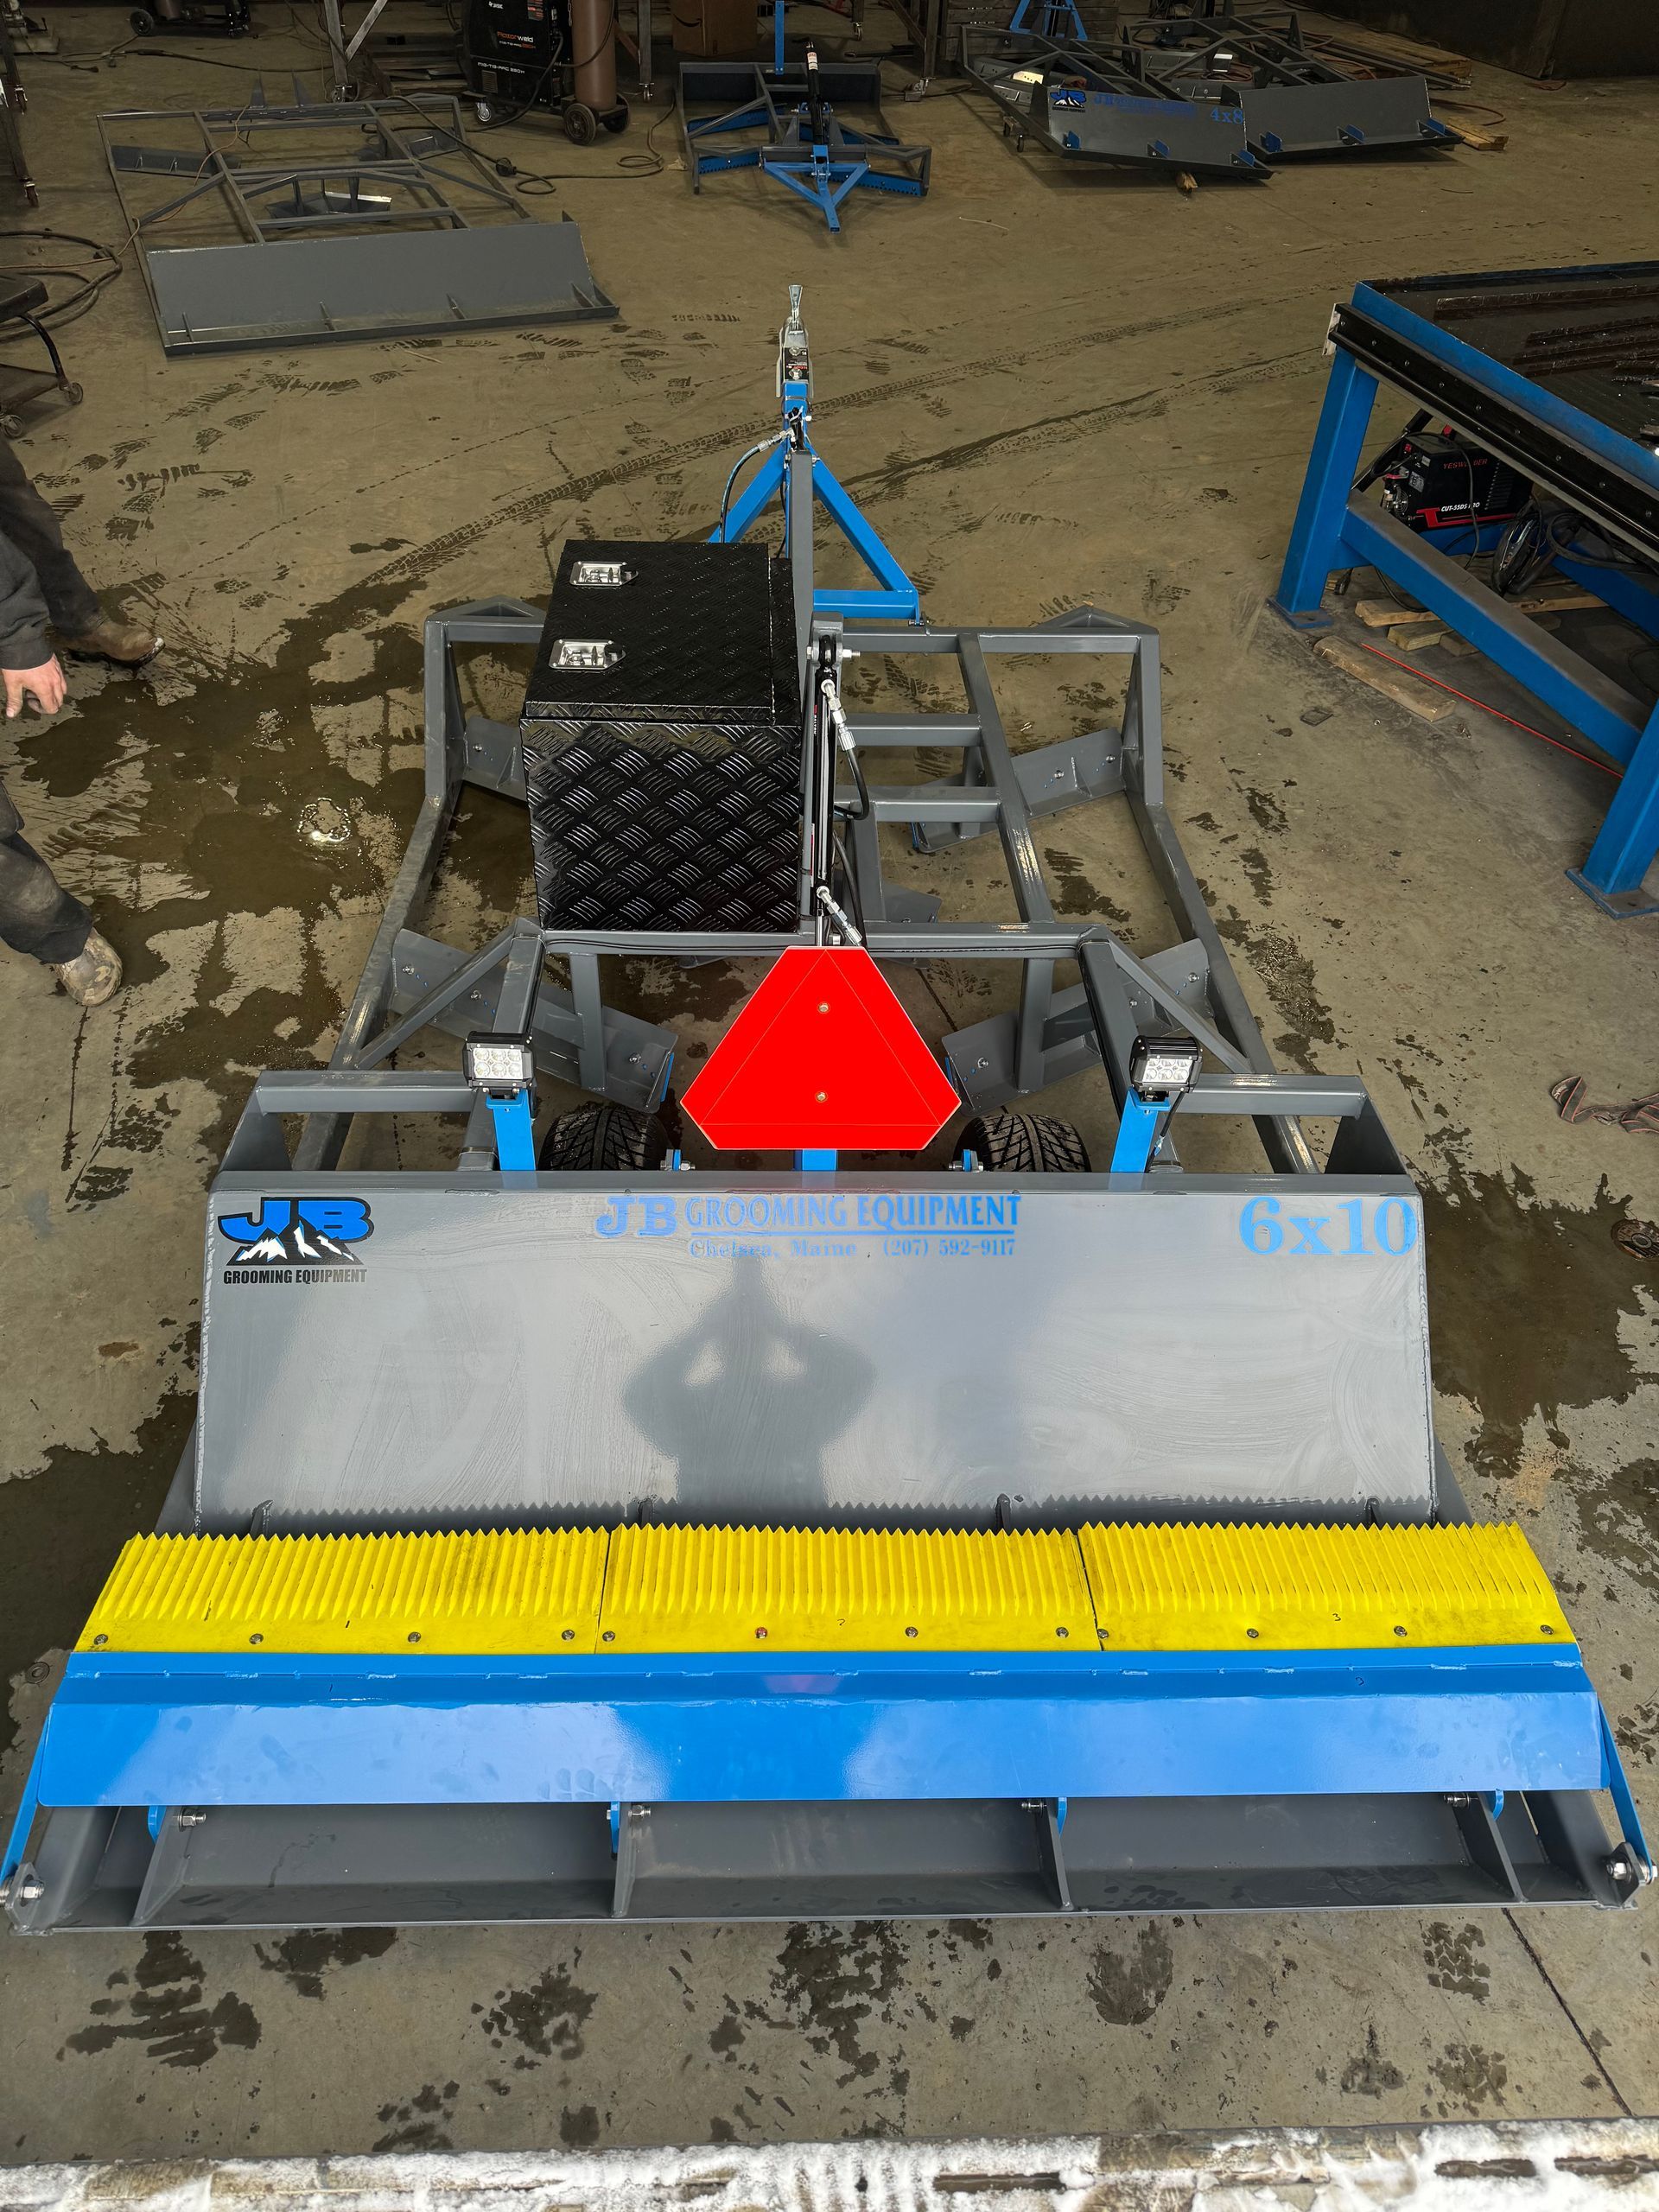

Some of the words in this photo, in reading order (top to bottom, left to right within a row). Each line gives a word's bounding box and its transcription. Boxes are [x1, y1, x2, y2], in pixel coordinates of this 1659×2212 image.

[1211, 107, 1243, 124] 4x8
[1443, 458, 1488, 469] YESWDER
[218, 1197, 375, 1245] JB
[594, 1195, 678, 1238] JB
[685, 1195, 848, 1228] GROOMING
[857, 1195, 1022, 1231] EQUIPMENT
[1239, 1196, 1418, 1256] 6x10
[790, 1239, 856, 1256] Maine
[883, 1238, 929, 1258] (207)
[939, 1238, 1016, 1256] 592-9117
[223, 1269, 292, 1284] GROOMING
[296, 1268, 367, 1284] EQUIPMENT
